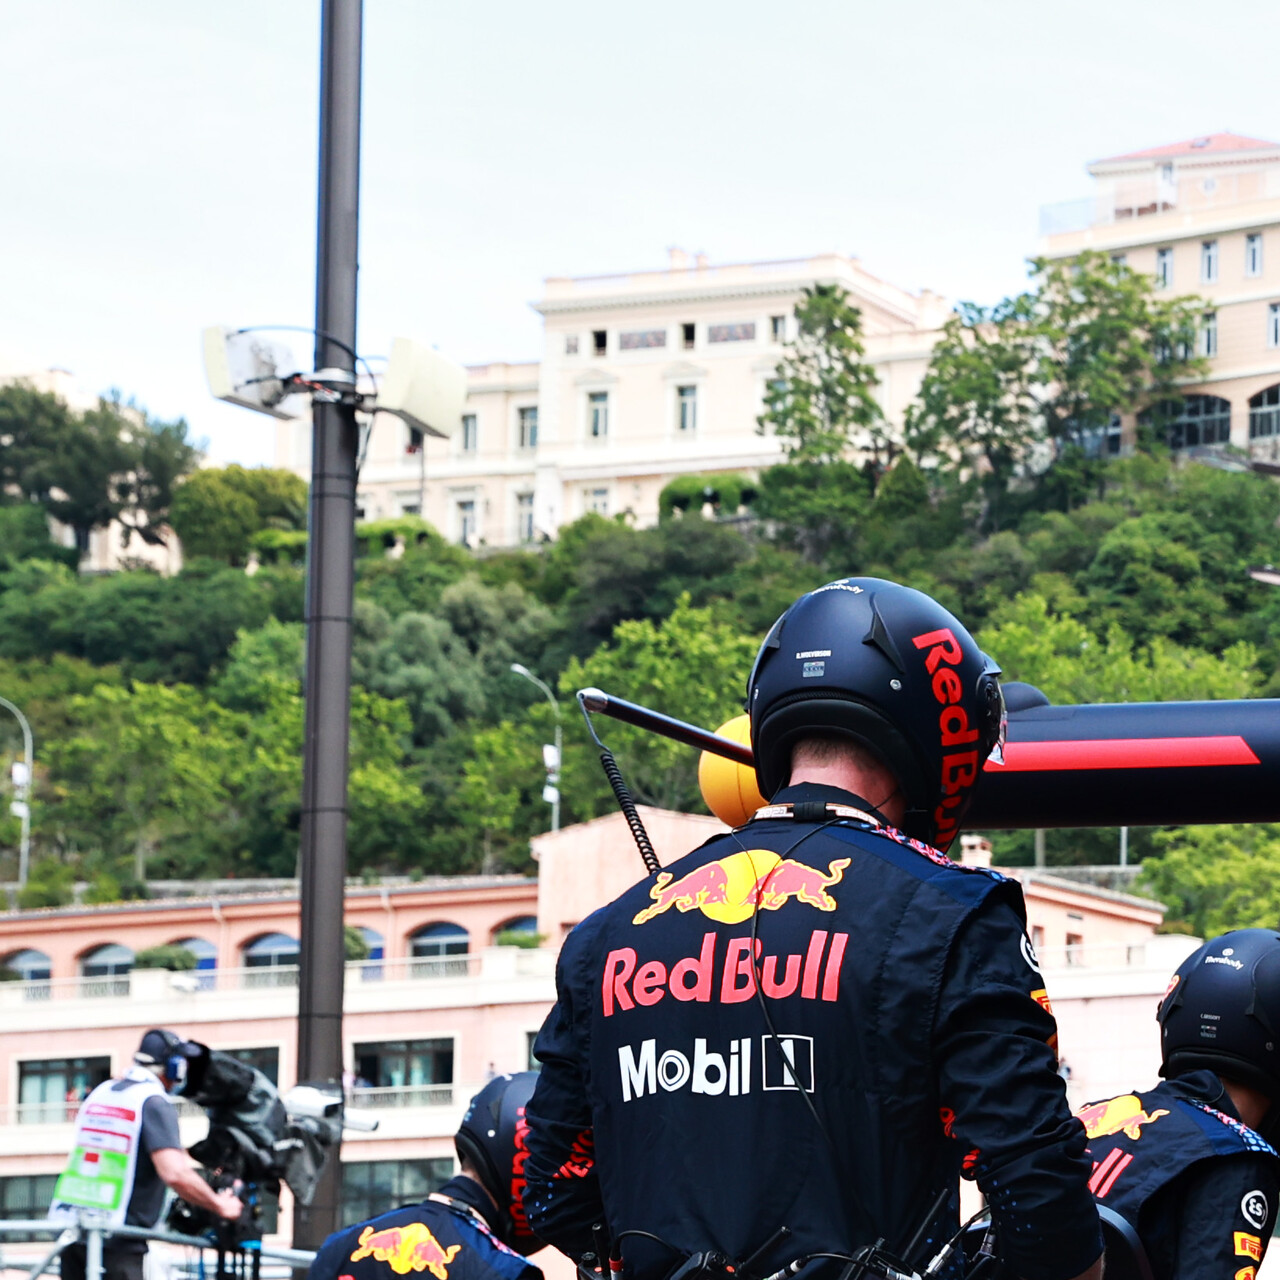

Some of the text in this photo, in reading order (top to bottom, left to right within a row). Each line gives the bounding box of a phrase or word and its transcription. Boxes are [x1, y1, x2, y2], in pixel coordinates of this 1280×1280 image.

[911, 627, 980, 747] Red
[602, 930, 849, 1017] Red Bull
[618, 1038, 751, 1102] Mobil
